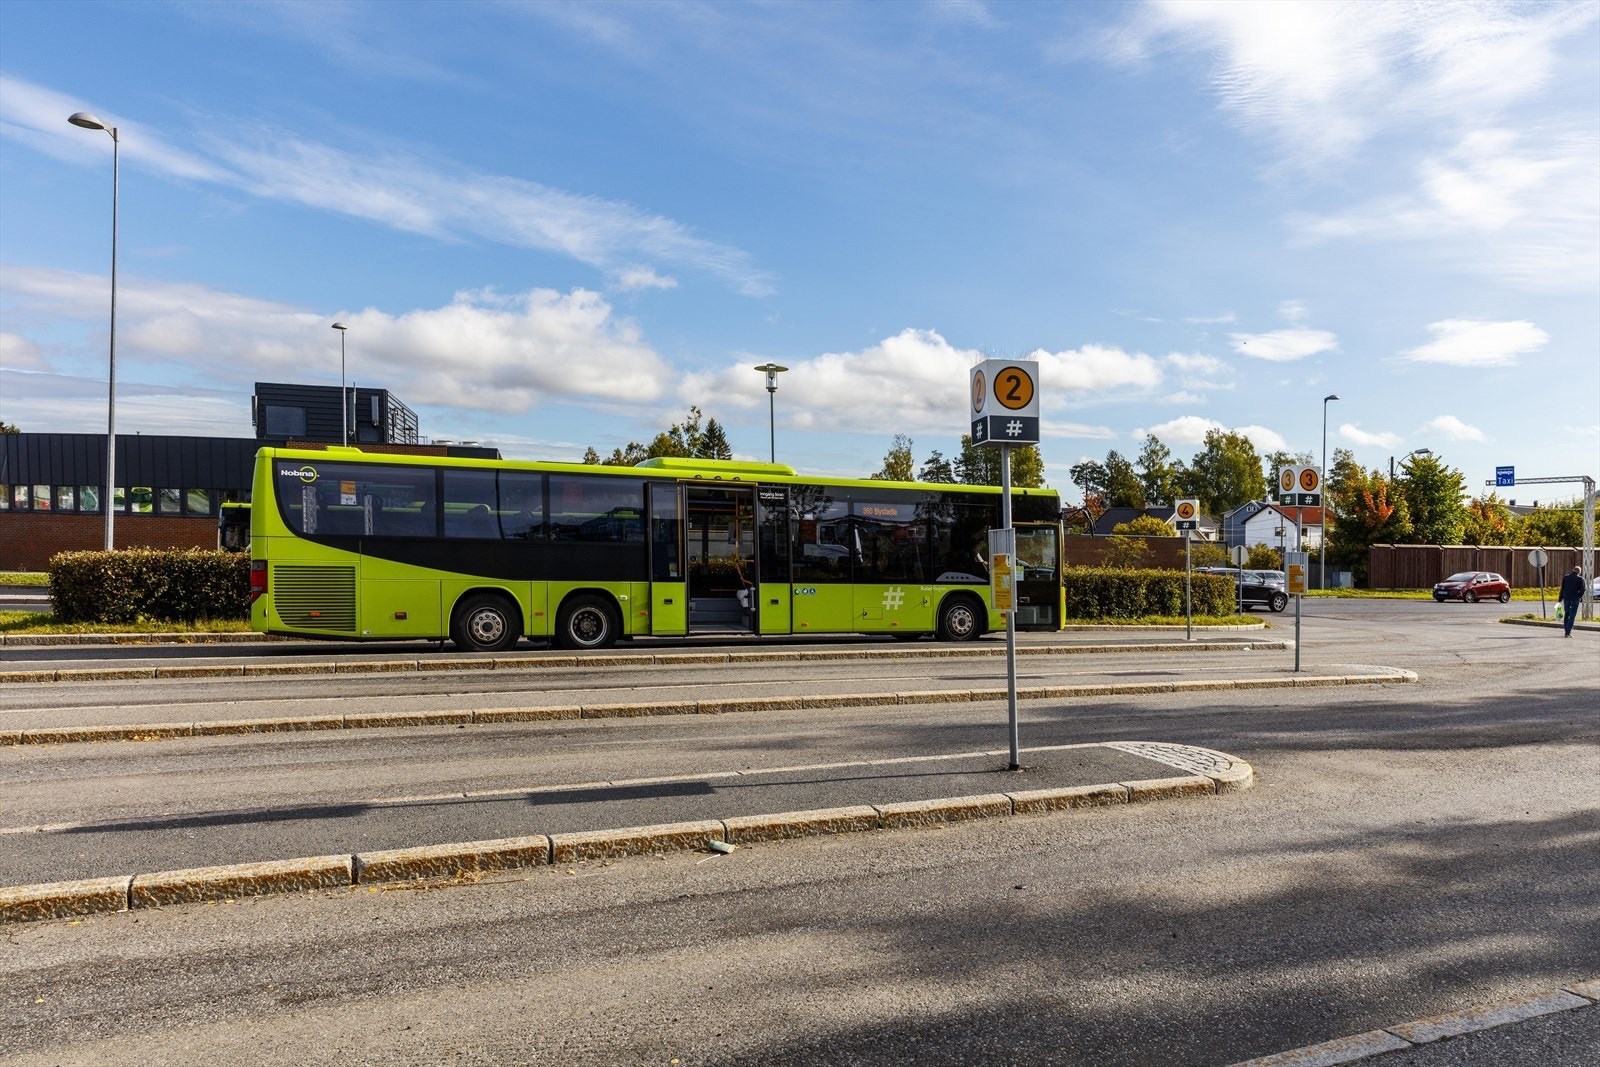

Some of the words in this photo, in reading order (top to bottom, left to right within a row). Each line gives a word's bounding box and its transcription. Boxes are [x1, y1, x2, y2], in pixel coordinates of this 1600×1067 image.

[976, 378, 982, 405] 2
[1006, 374, 1022, 401] 2
[281, 469, 314, 477] Nobina
[1285, 473, 1291, 486] 3
[1305, 473, 1313, 486] 3
[1498, 477, 1514, 485] Taxi
[1182, 505, 1189, 515] 4
